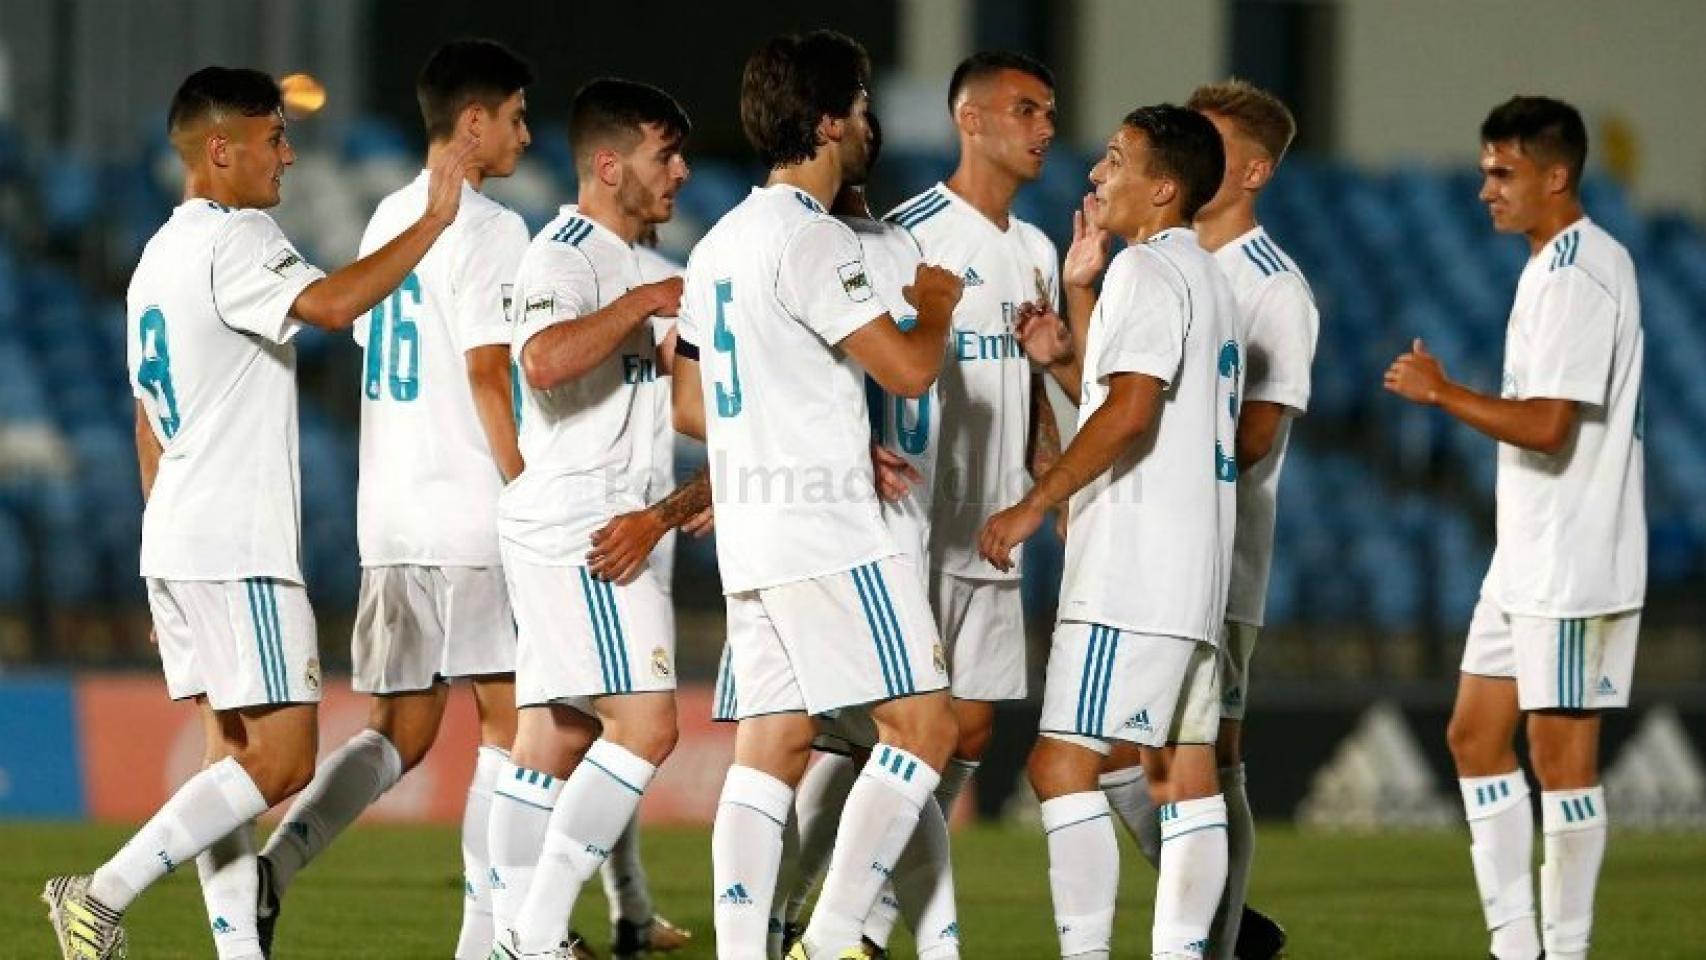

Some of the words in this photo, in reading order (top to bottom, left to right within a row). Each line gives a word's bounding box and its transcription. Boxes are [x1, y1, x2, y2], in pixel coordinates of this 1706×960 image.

[138, 304, 181, 439] 9
[366, 272, 421, 401] 16
[714, 278, 742, 418] 5
